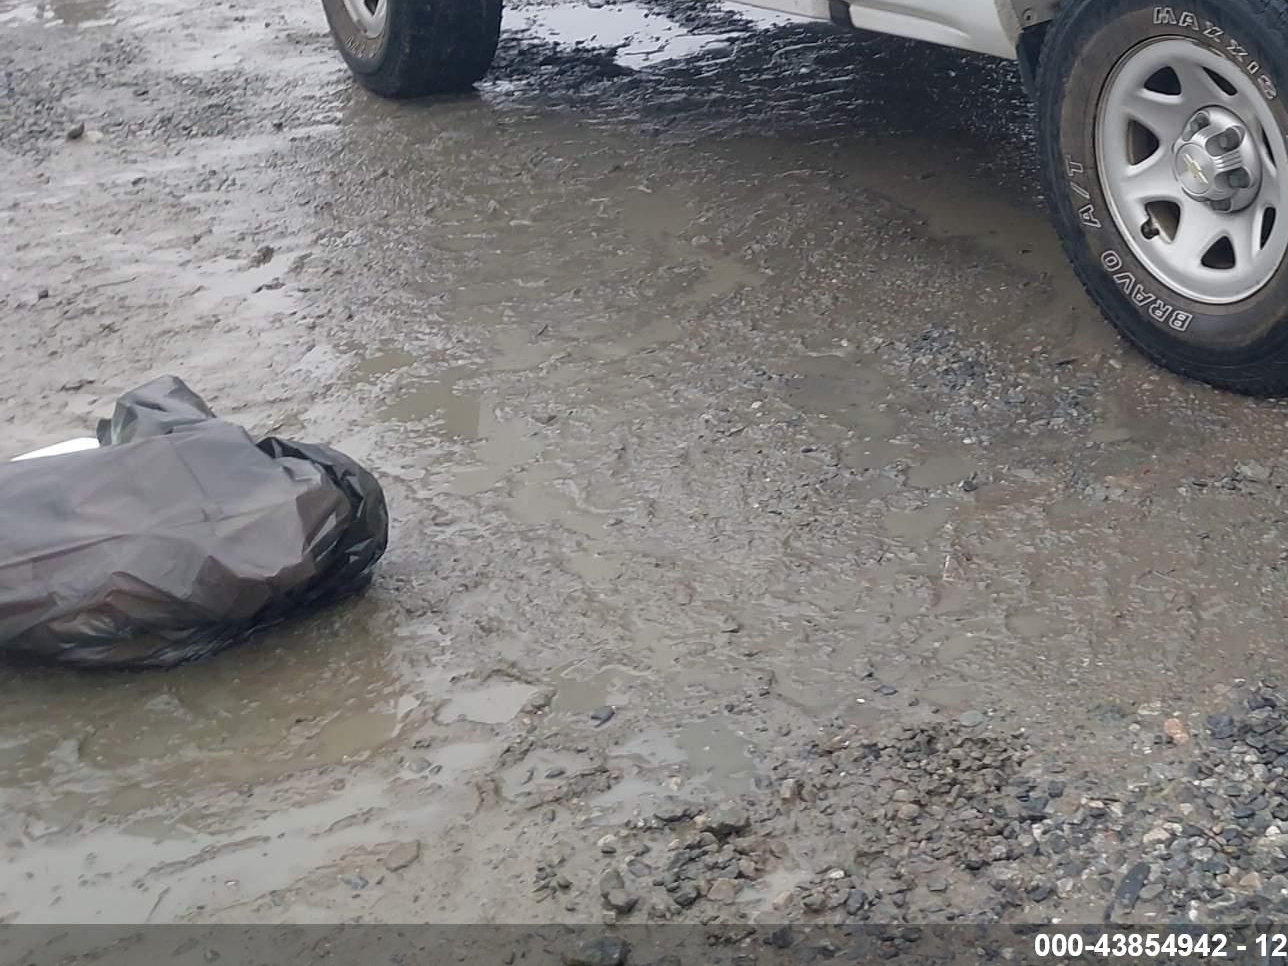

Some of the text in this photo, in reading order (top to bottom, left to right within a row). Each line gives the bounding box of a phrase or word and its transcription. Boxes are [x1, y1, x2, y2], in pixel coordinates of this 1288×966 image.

[1152, 6, 1278, 100] MAXXIS
[1065, 154, 1193, 332] BRAVO A/T
